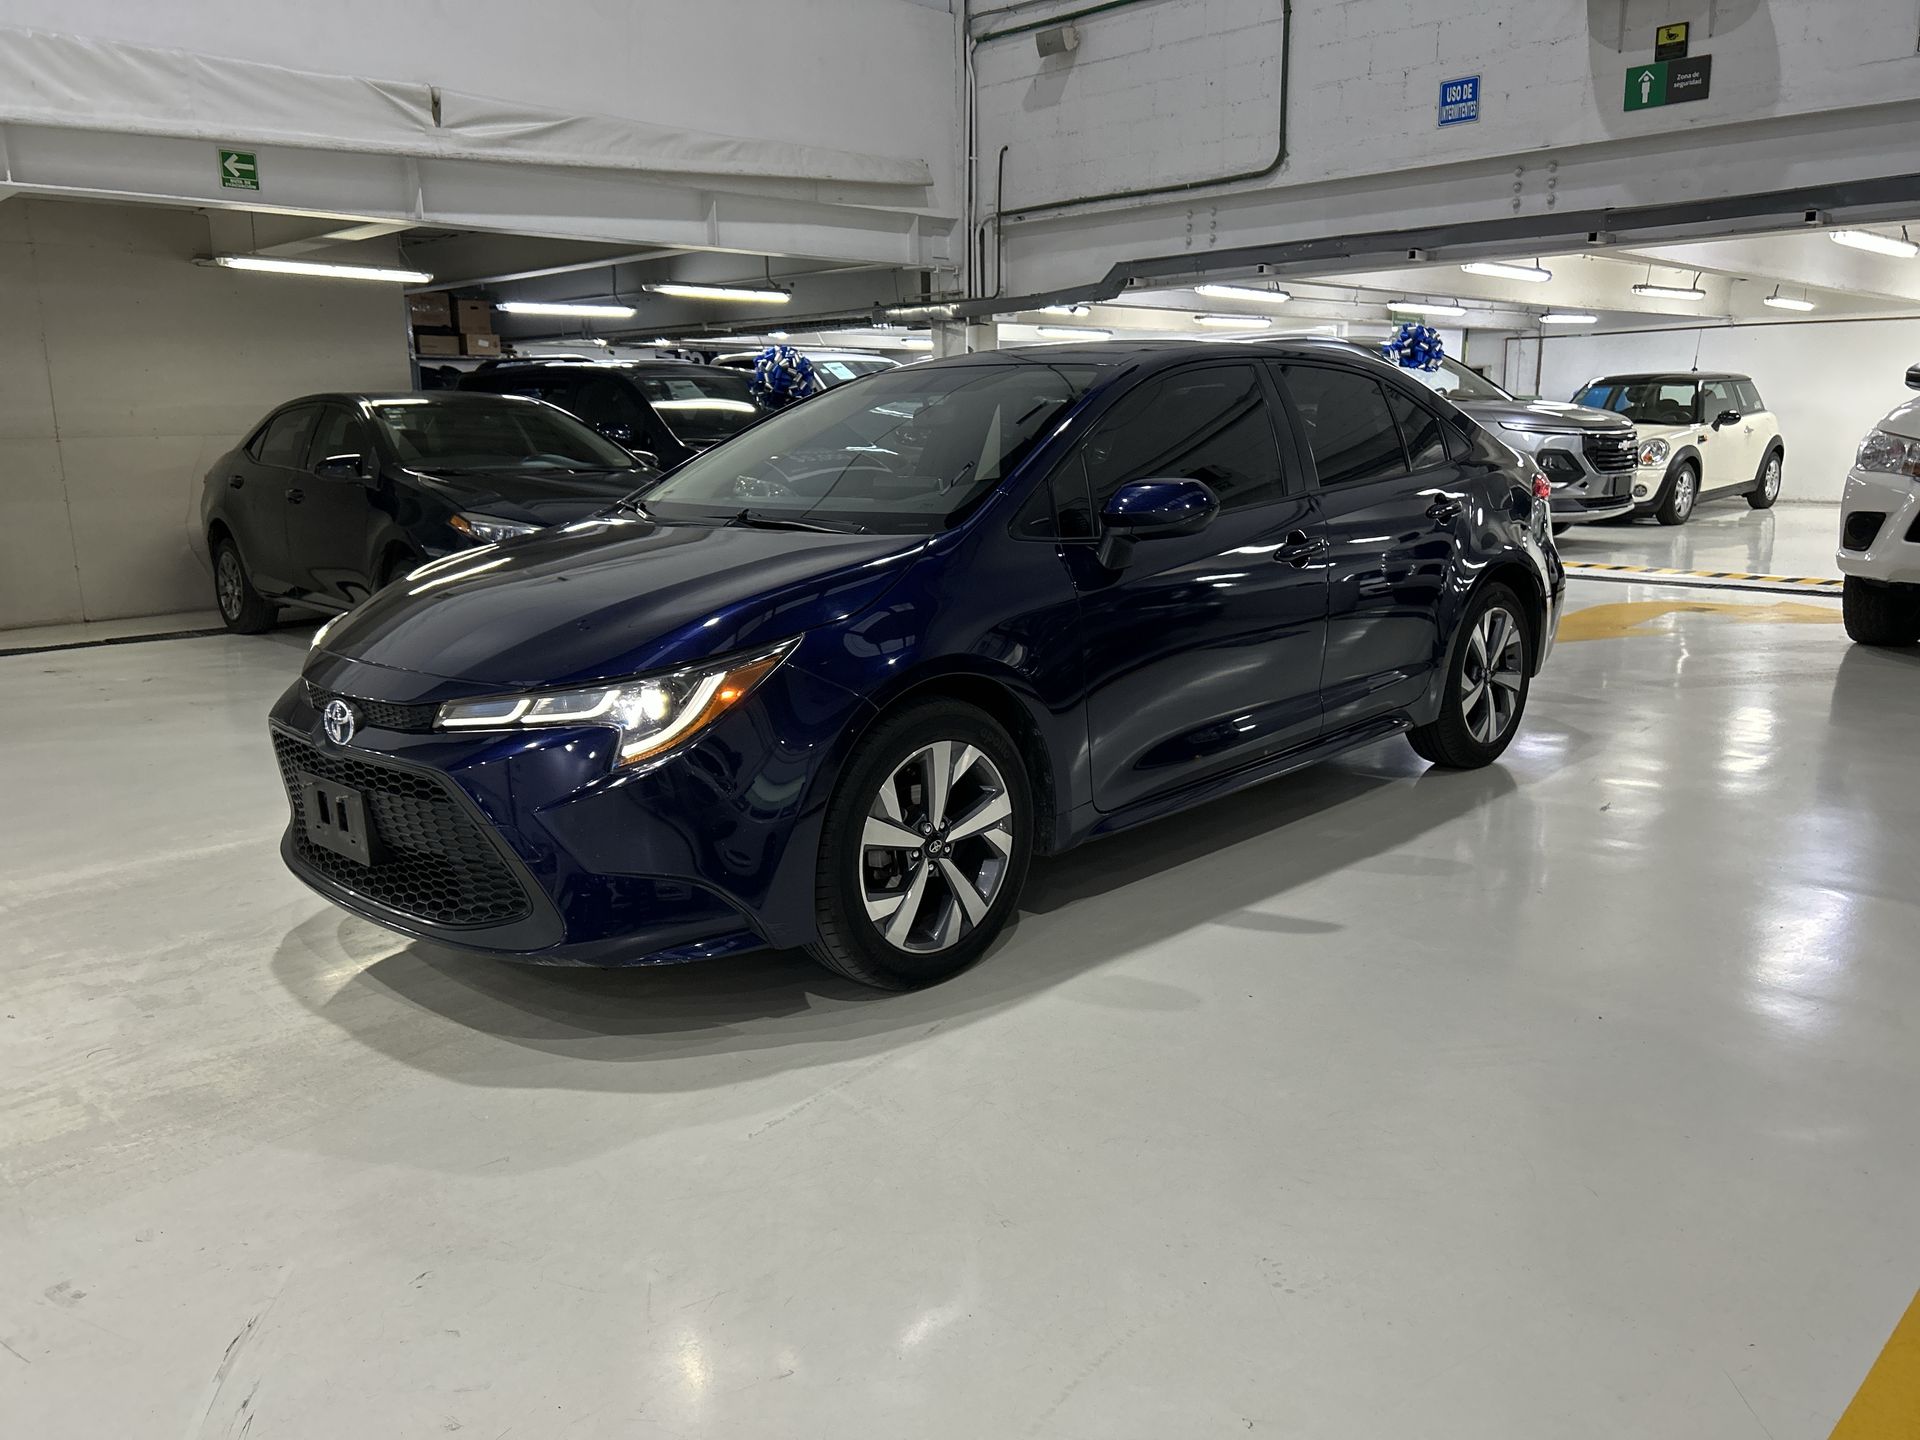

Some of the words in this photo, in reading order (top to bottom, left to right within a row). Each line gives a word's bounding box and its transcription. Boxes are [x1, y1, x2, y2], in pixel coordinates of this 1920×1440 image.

[1676, 72, 1691, 81] Zona
[1446, 85, 1461, 103] USO
[1463, 83, 1473, 100] DE
